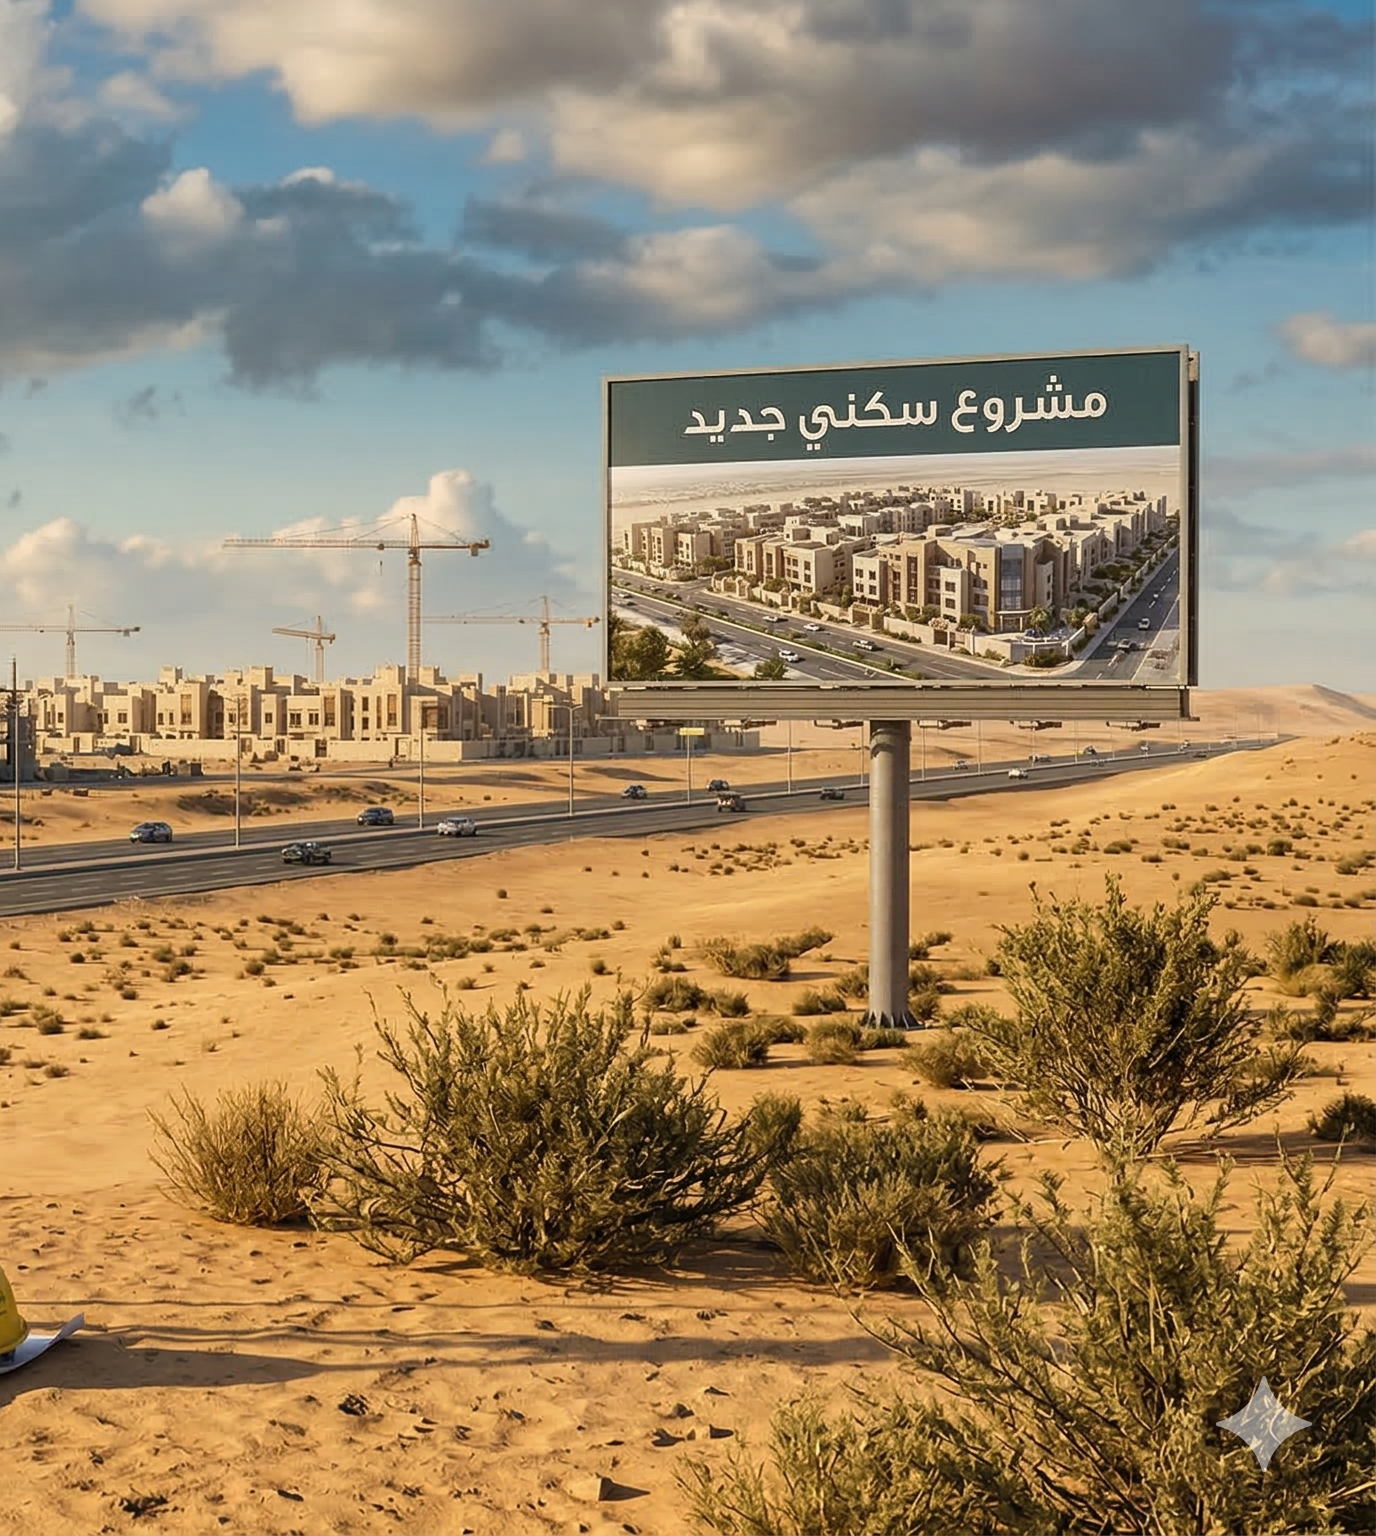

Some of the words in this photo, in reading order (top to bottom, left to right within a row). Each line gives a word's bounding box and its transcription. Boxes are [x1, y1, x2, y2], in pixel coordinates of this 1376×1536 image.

[683, 406, 786, 443] جديد
[799, 391, 937, 451] سكني
[951, 375, 1107, 433] مشروع
